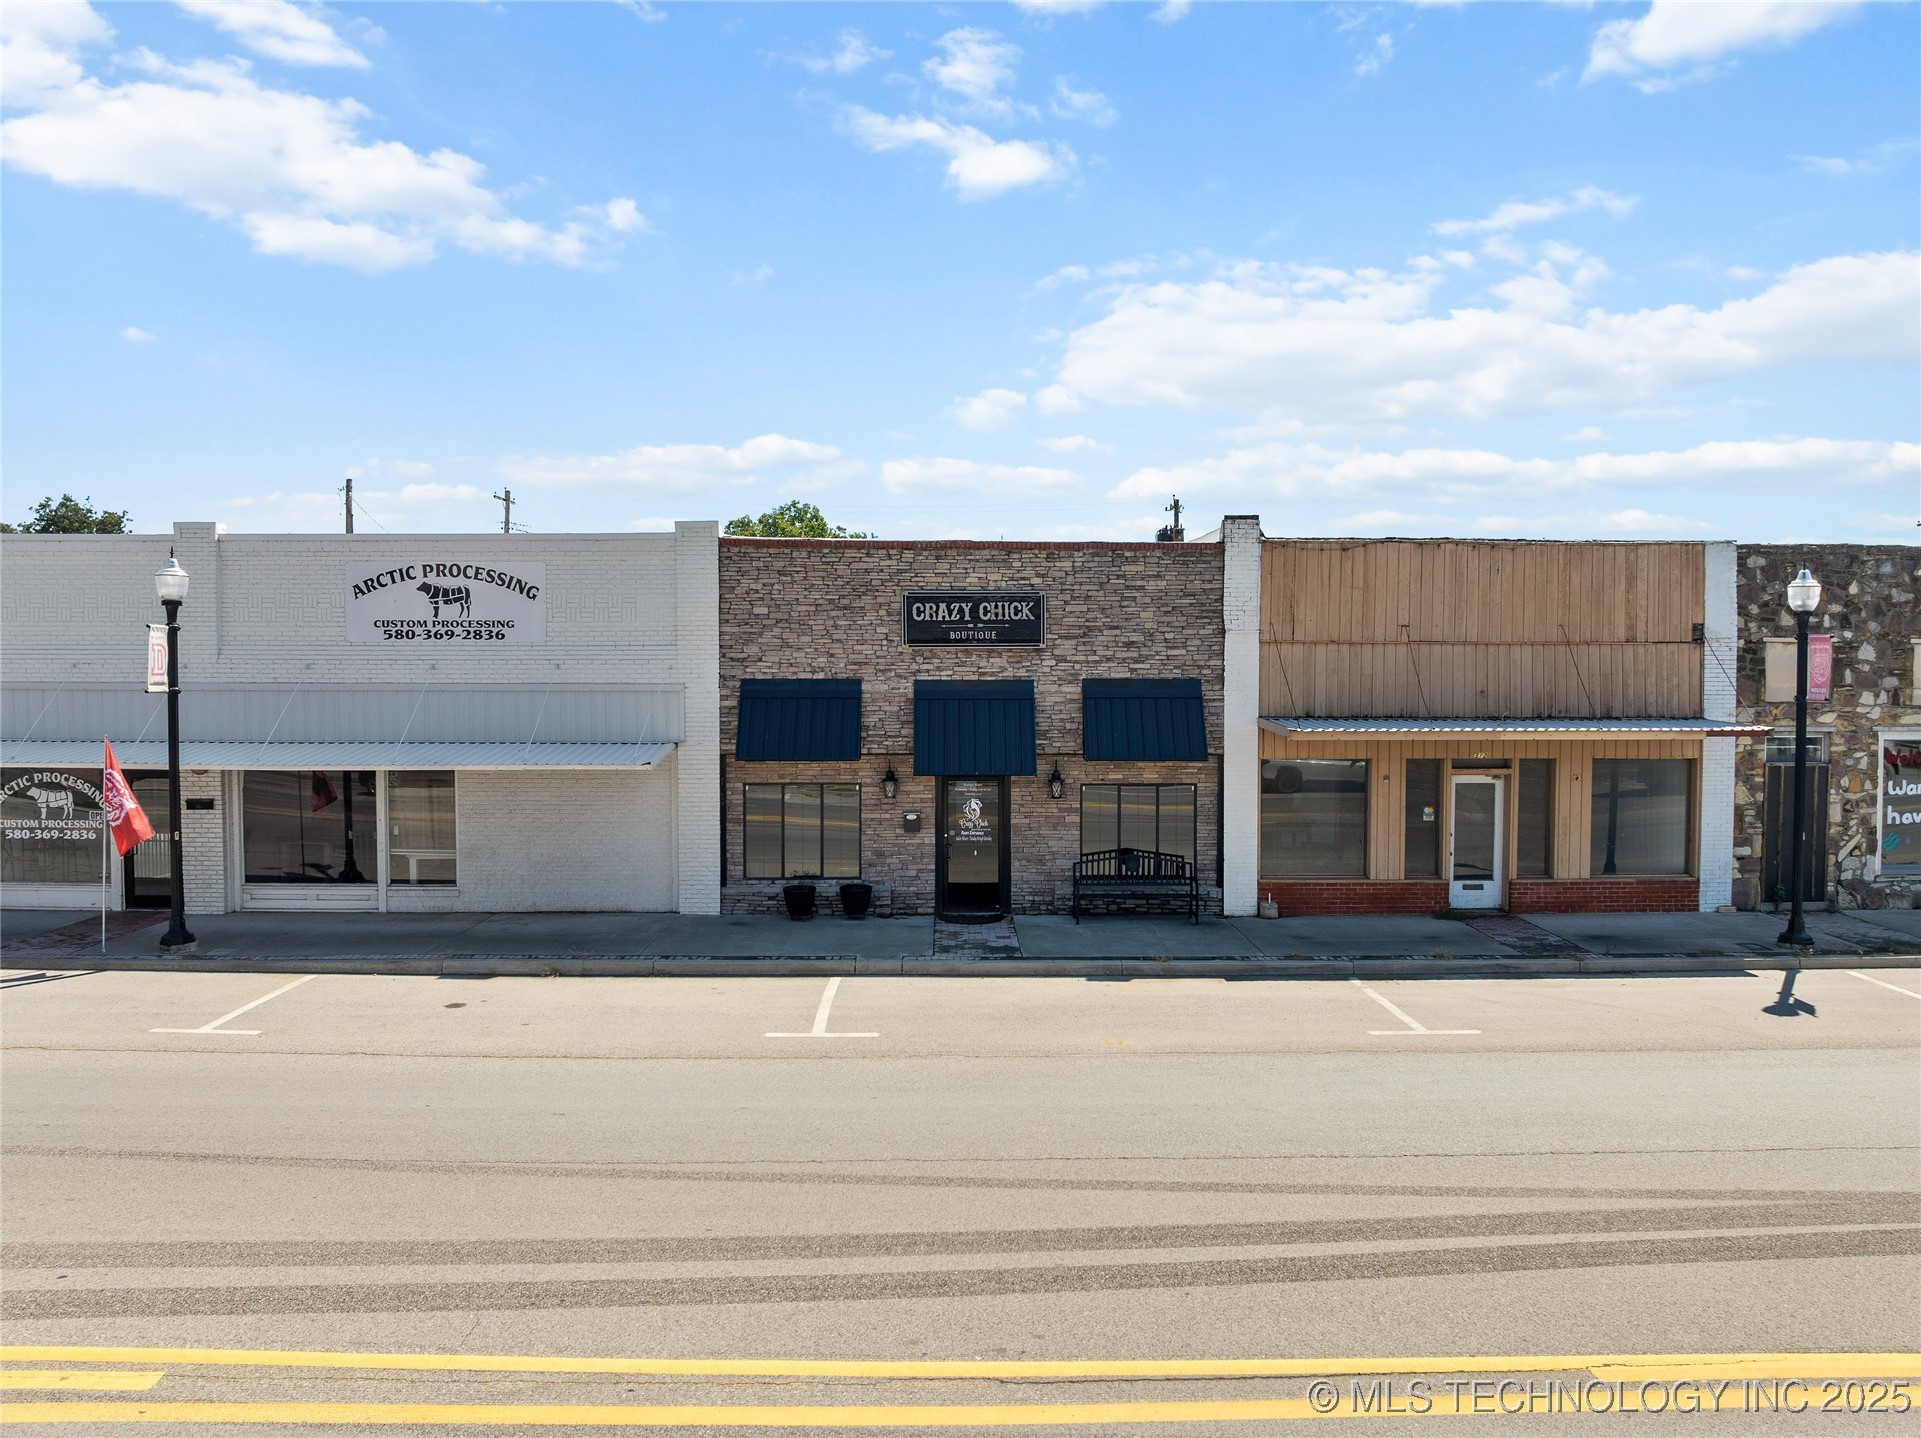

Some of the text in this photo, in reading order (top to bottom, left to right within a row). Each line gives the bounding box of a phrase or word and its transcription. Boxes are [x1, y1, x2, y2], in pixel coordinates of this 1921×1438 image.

[352, 563, 540, 601] ARCTIC PROCESSING
[911, 602, 1035, 621] CRAZY CHICK
[373, 619, 515, 629] CUSTOM PROCESSING
[383, 629, 506, 640] 580-369-2836
[950, 631, 997, 640] BOUTIQUE
[151, 643, 167, 677] D
[90, 811, 105, 819] OPE
[41, 819, 104, 828] PROCESSING
[5, 829, 97, 840] 580-369-2836
